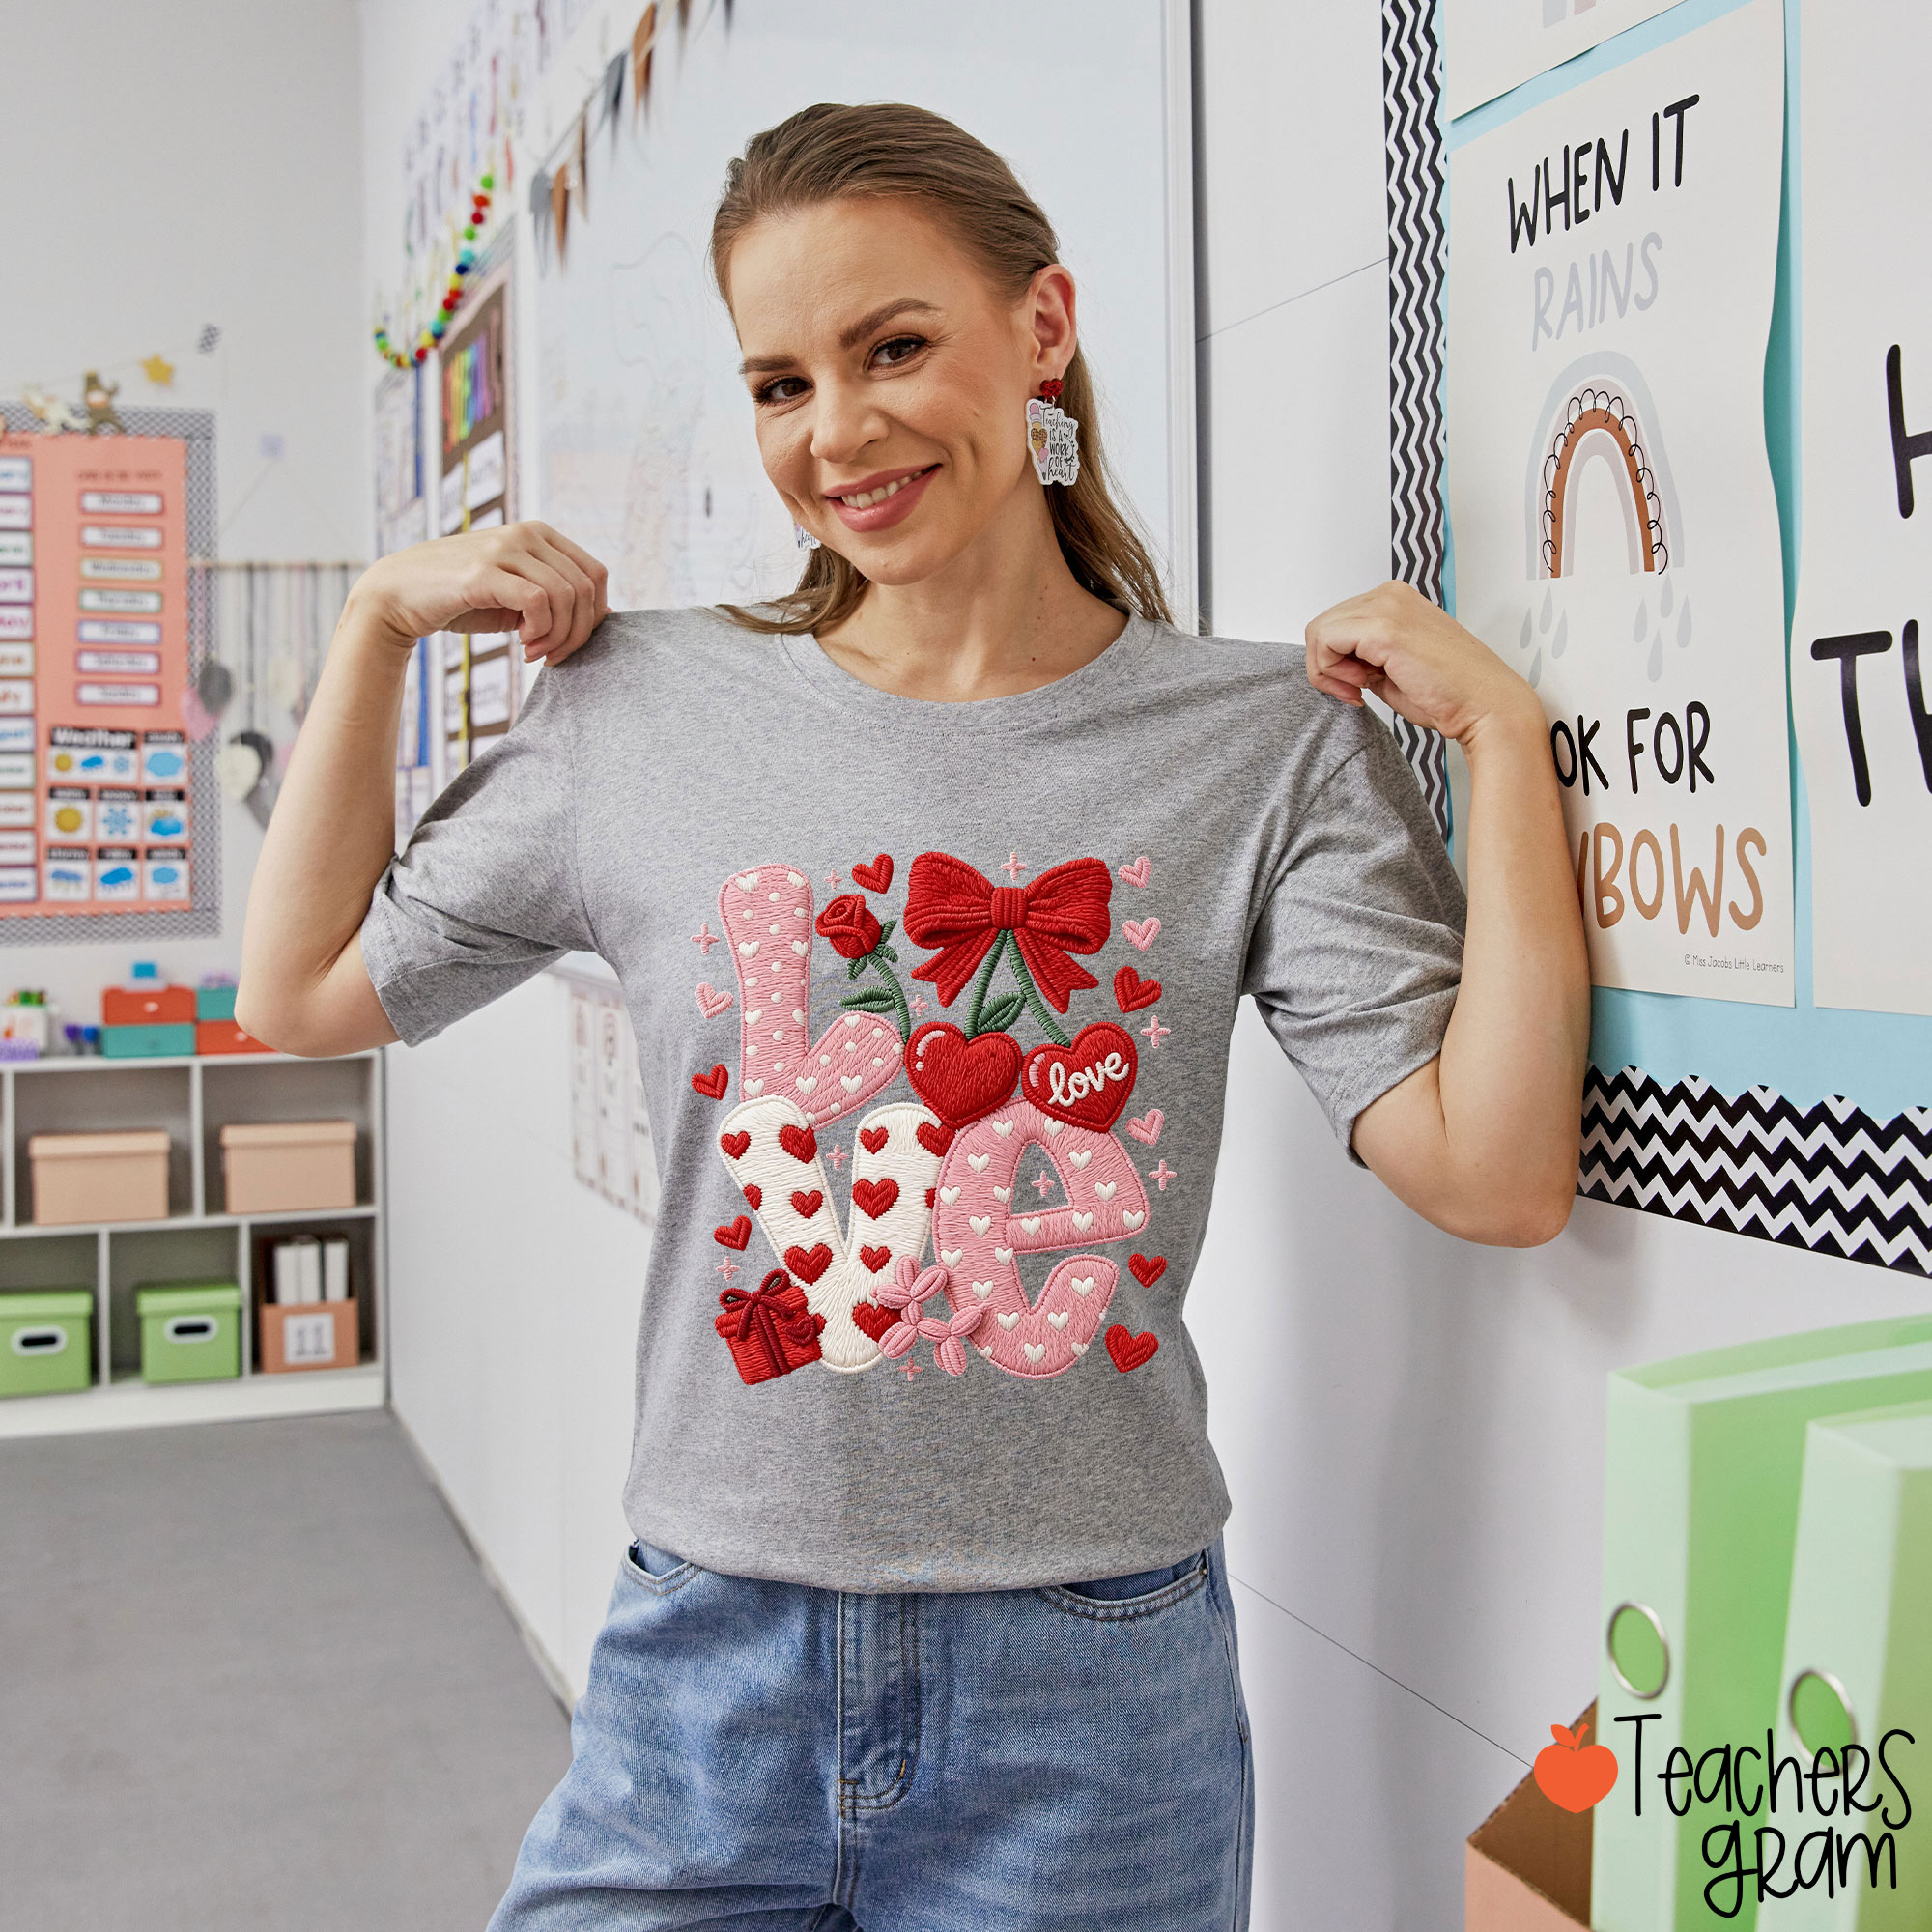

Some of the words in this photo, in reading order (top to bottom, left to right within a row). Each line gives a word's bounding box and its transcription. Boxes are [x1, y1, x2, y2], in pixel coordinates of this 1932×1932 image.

[1508, 128, 1629, 253] WHEN
[1652, 94, 1700, 192] IT
[1531, 232, 1662, 352] RAINS
[1039, 405, 1075, 438] Teaching
[1058, 429, 1064, 443] A
[1049, 442, 1069, 456] WORK
[1054, 456, 1064, 468] OF
[1047, 457, 1076, 481] heart
[1550, 715, 1609, 796] OK
[1627, 701, 1715, 794] FOR
[1577, 822, 1767, 938] BOWS
[1692, 954, 1706, 967] Miss
[1707, 955, 1732, 969] Jacobs
[1734, 957, 1750, 970] Little
[1752, 959, 1784, 973] Learners
[1047, 1050, 1129, 1108] love
